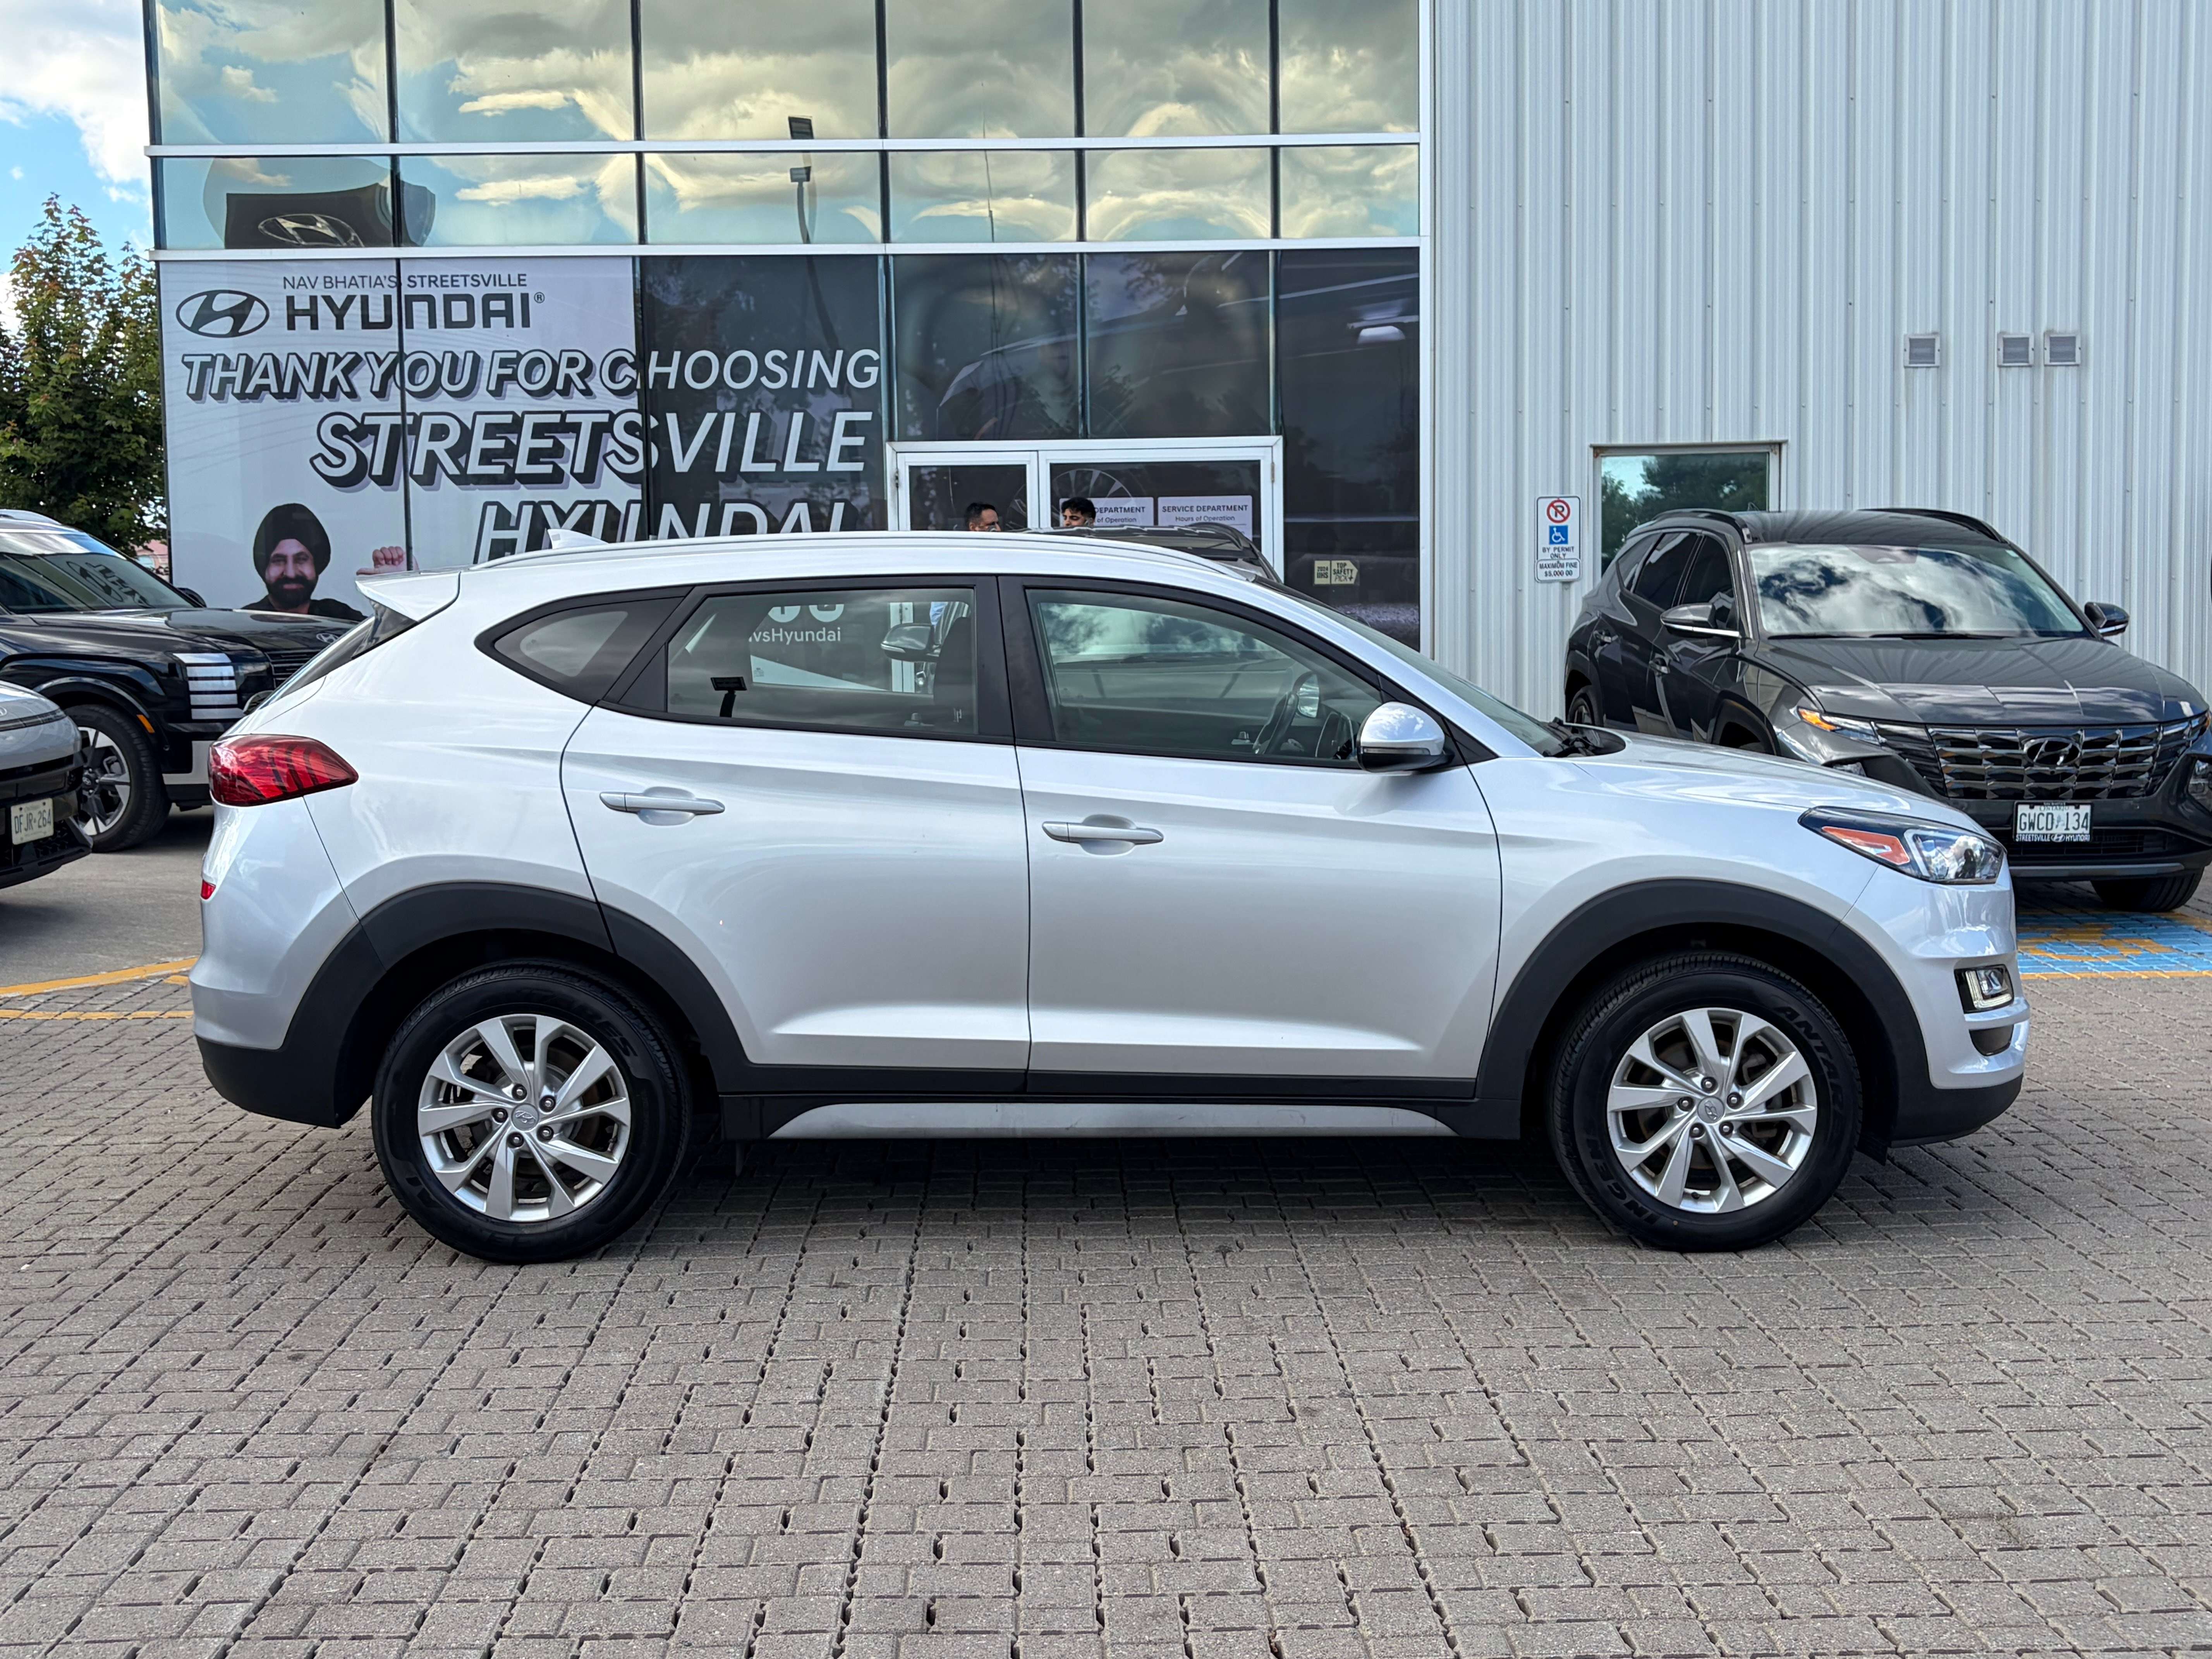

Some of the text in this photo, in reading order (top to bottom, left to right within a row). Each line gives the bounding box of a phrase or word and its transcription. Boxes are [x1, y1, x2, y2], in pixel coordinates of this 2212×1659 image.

[283, 273, 527, 289] NAV BHATIA'S STREETSVILLE
[286, 292, 530, 331] HYUNDAI
[182, 348, 881, 401] THANK YOU FOR CHOOSING
[309, 409, 874, 489] STREETSVILLE
[38, 808, 52, 828] 264
[2019, 812, 2089, 831] GWCD 134
[2016, 834, 2051, 842] STREETSVILLE
[1774, 1005, 1845, 1139] ANTAR
[1583, 1119, 1660, 1224] INGEN
